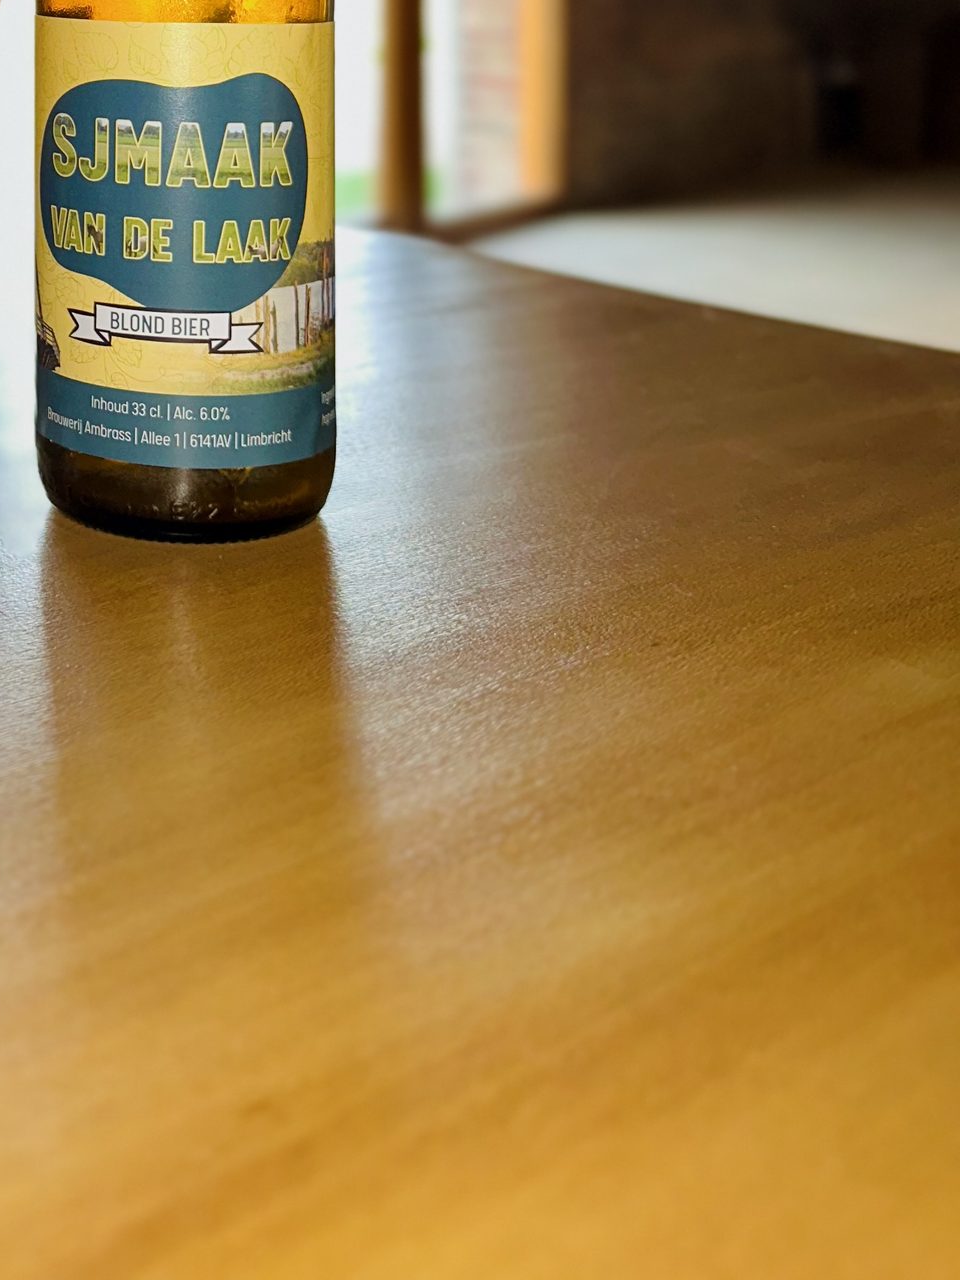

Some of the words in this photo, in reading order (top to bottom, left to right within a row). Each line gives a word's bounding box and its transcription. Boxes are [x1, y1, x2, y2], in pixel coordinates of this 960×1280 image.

[52, 112, 293, 188] SJMAAK
[50, 205, 106, 256] VAN
[123, 216, 173, 262] DE
[193, 218, 291, 263] LAAK
[110, 311, 165, 335] BLOND
[171, 317, 210, 336] BIER
[47, 406, 82, 434] Brouwerij
[84, 421, 131, 442] Ambrass
[141, 430, 170, 446] Allee
[174, 433, 180, 447] 1
[190, 433, 232, 448] 6141AV
[241, 428, 292, 447] Limbricht
[91, 395, 128, 415] Inhoud
[131, 402, 146, 417] 33
[149, 405, 163, 419] cl.
[173, 405, 196, 421] Alc.
[200, 406, 230, 421] 6.0%
